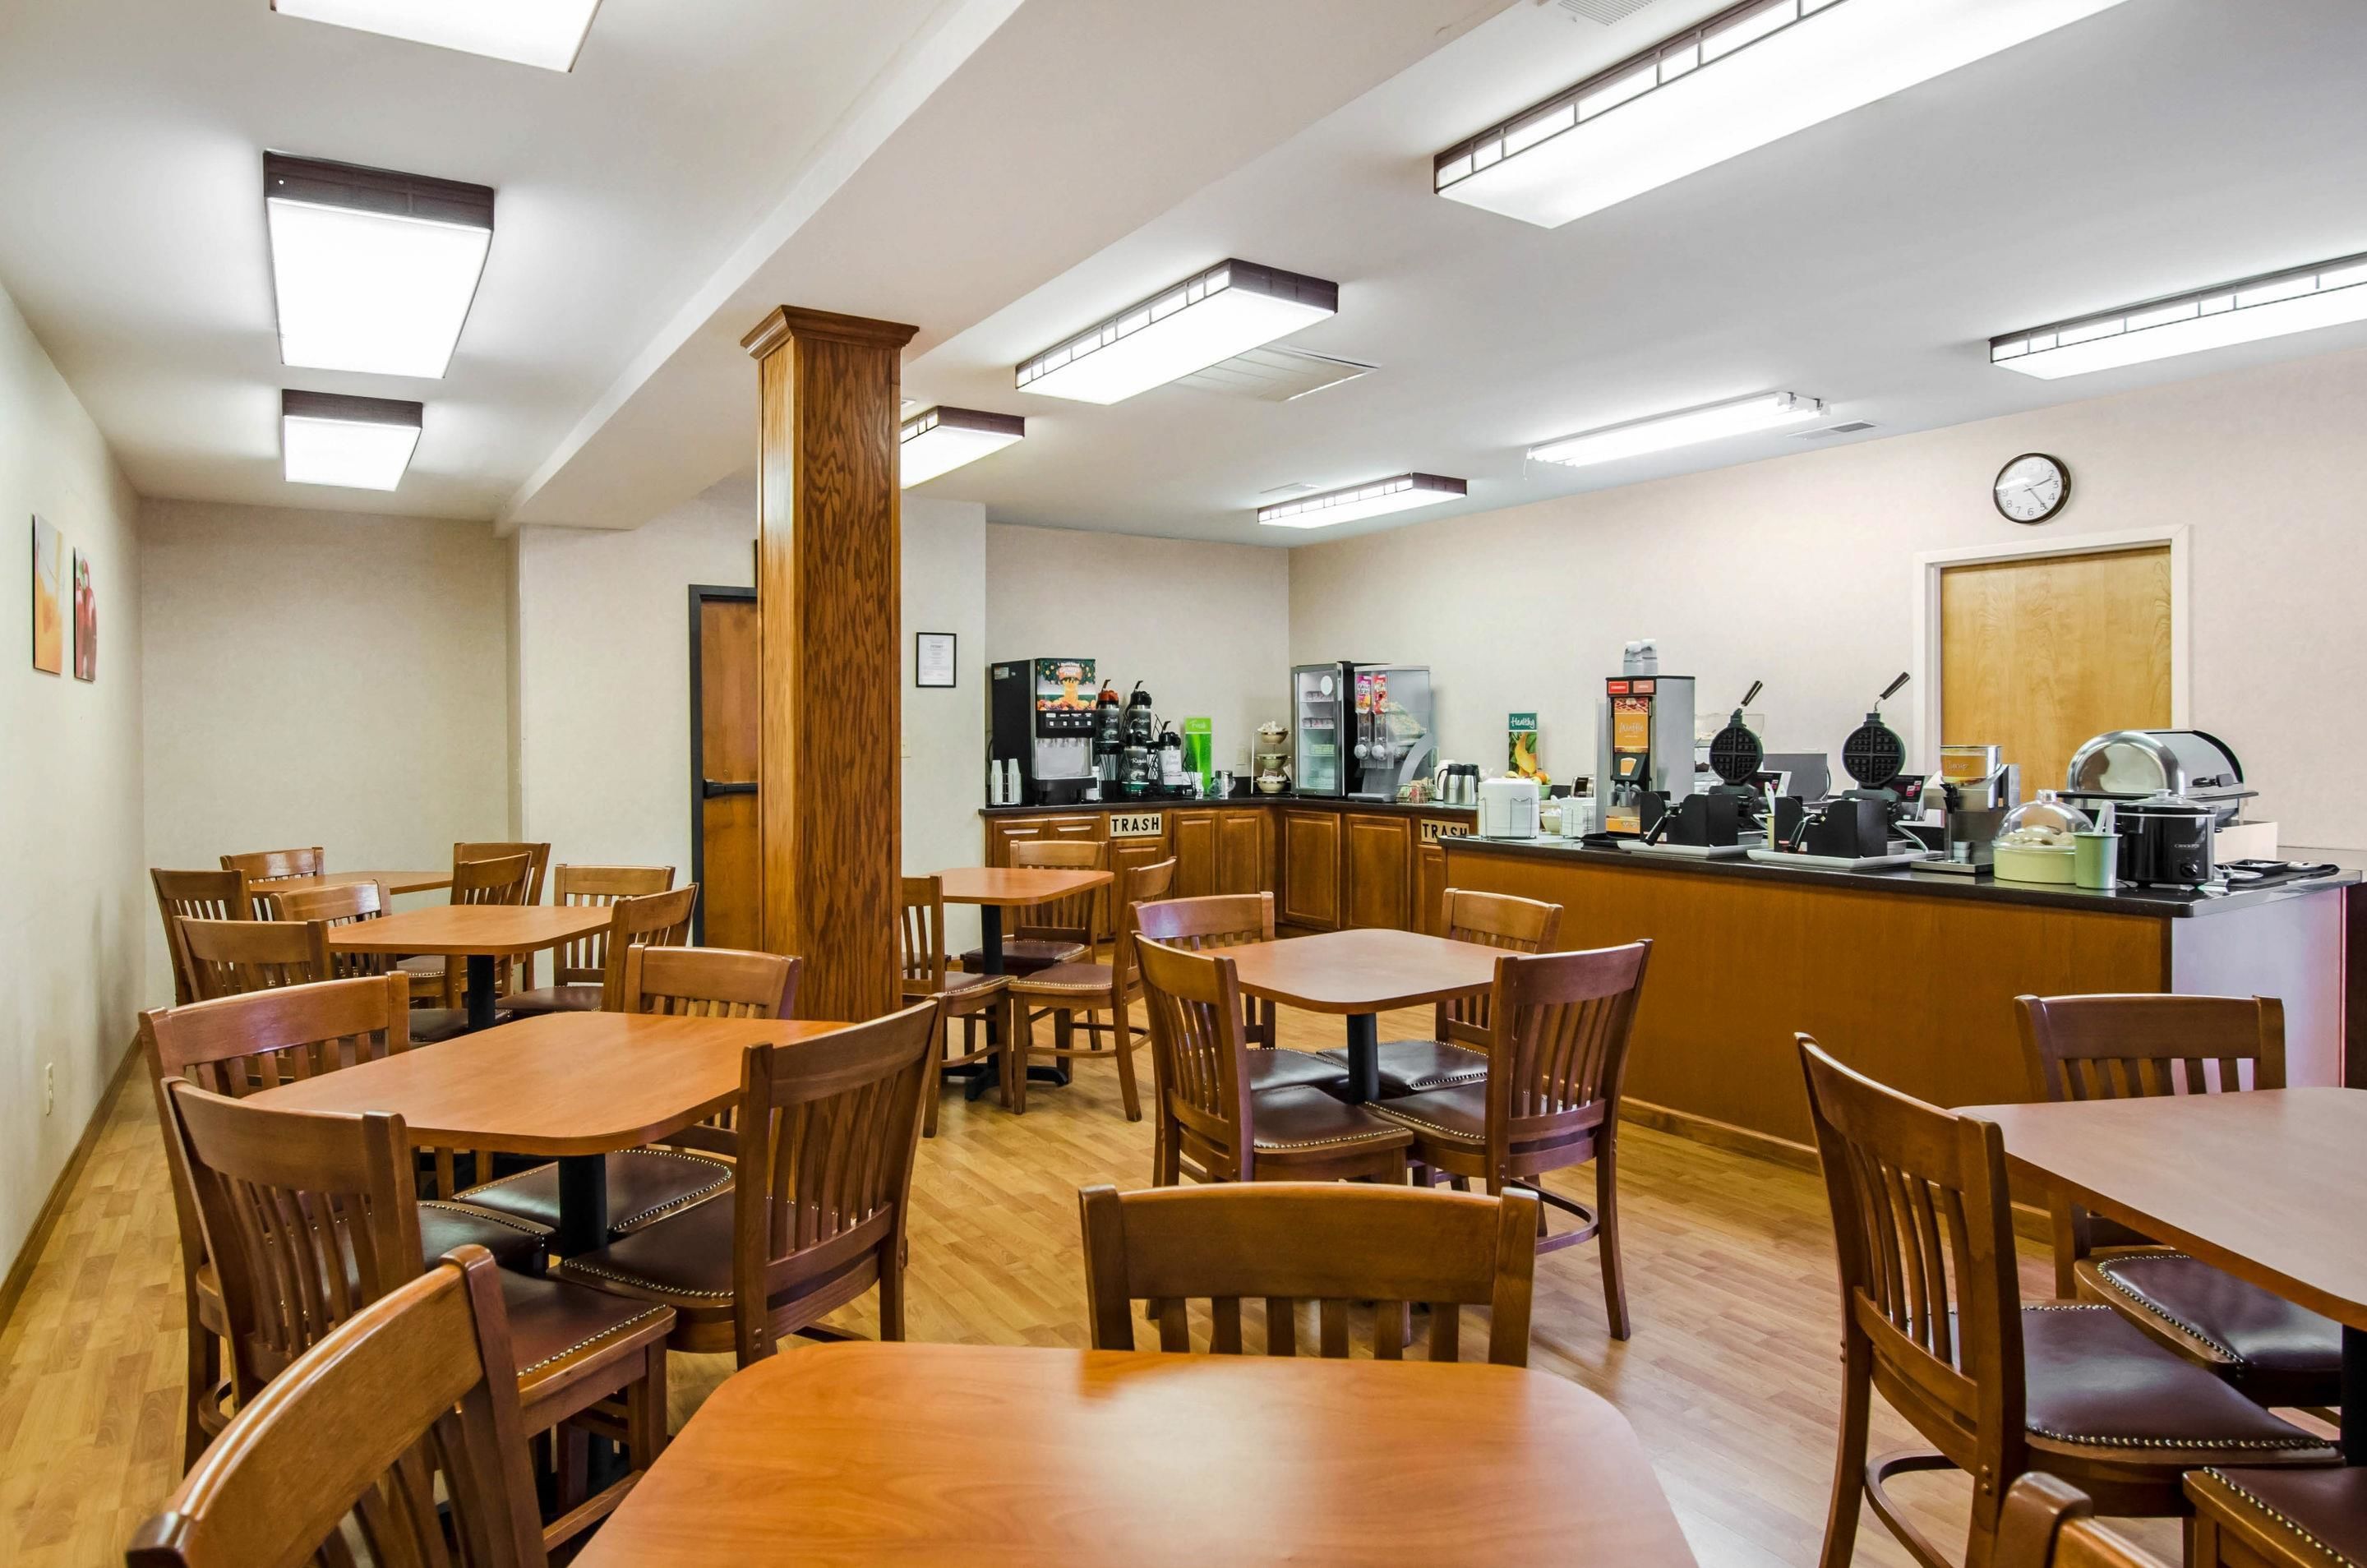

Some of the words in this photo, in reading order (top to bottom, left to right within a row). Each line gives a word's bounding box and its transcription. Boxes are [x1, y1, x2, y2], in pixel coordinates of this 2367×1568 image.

[2048, 469, 2055, 478] 2
[2052, 480, 2059, 489] 3
[2002, 489, 2009, 497] 9
[2048, 493, 2056, 501] 4
[2006, 500, 2013, 508] 8
[2015, 506, 2021, 514] 7
[2027, 508, 2034, 516] 6
[1511, 717, 1535, 729] Healthy
[1111, 817, 1159, 832] TRASH
